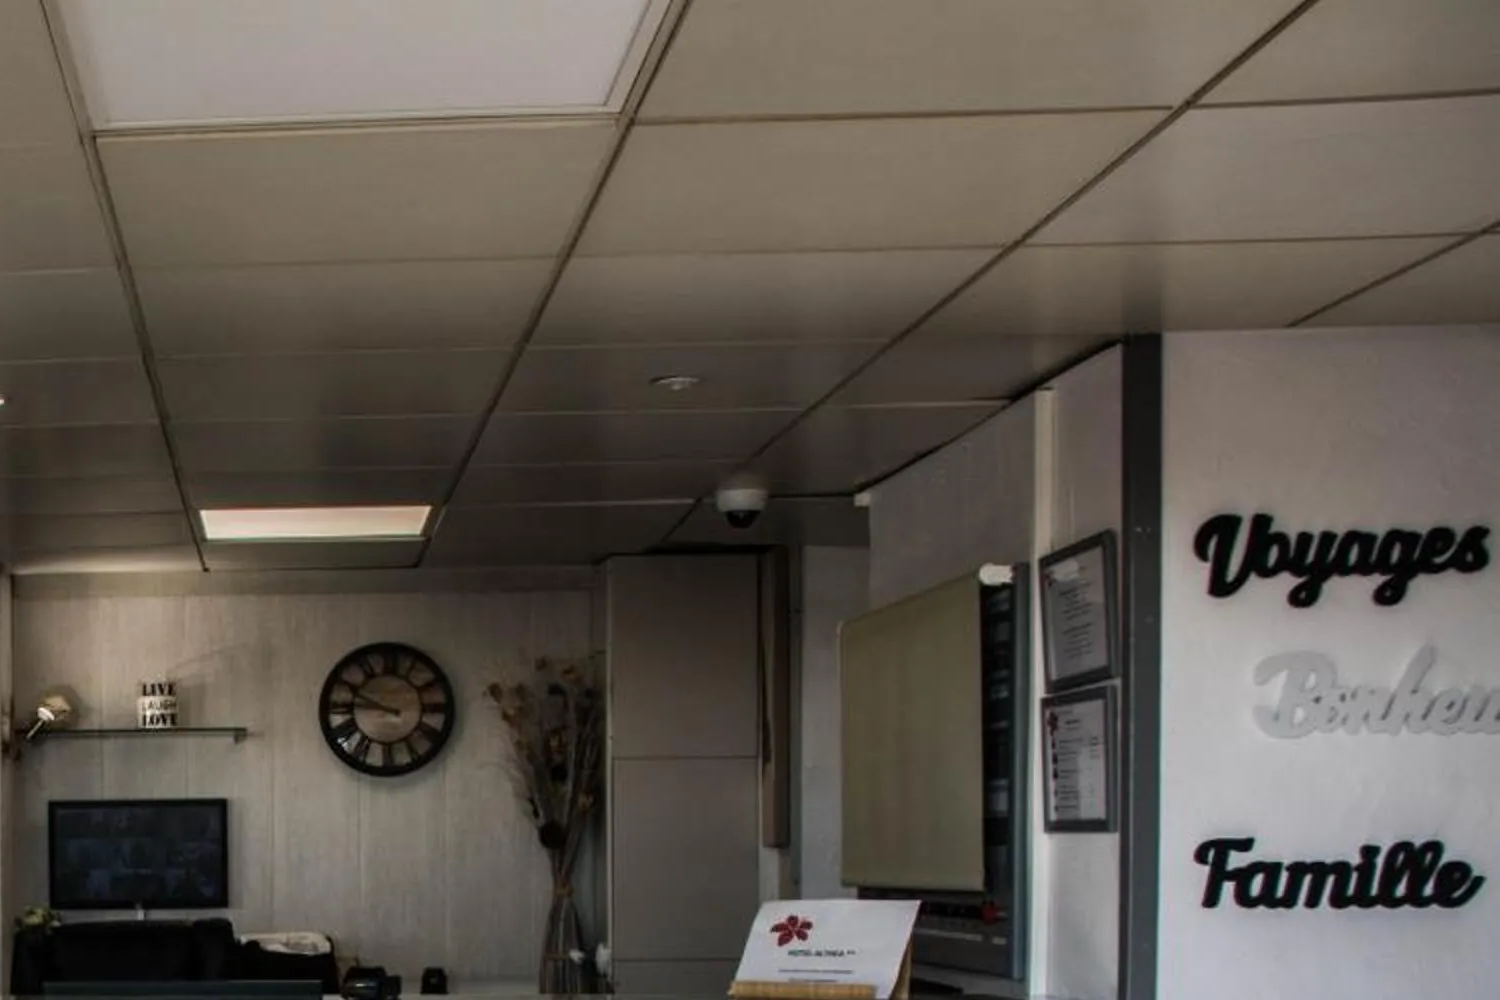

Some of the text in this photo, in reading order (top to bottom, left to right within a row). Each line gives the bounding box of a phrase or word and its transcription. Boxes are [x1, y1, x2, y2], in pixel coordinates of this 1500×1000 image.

[1194, 513, 1490, 608] Voyages
[142, 683, 176, 697] LIVE
[142, 713, 177, 726] LOVE
[1194, 837, 1486, 909] Famille
